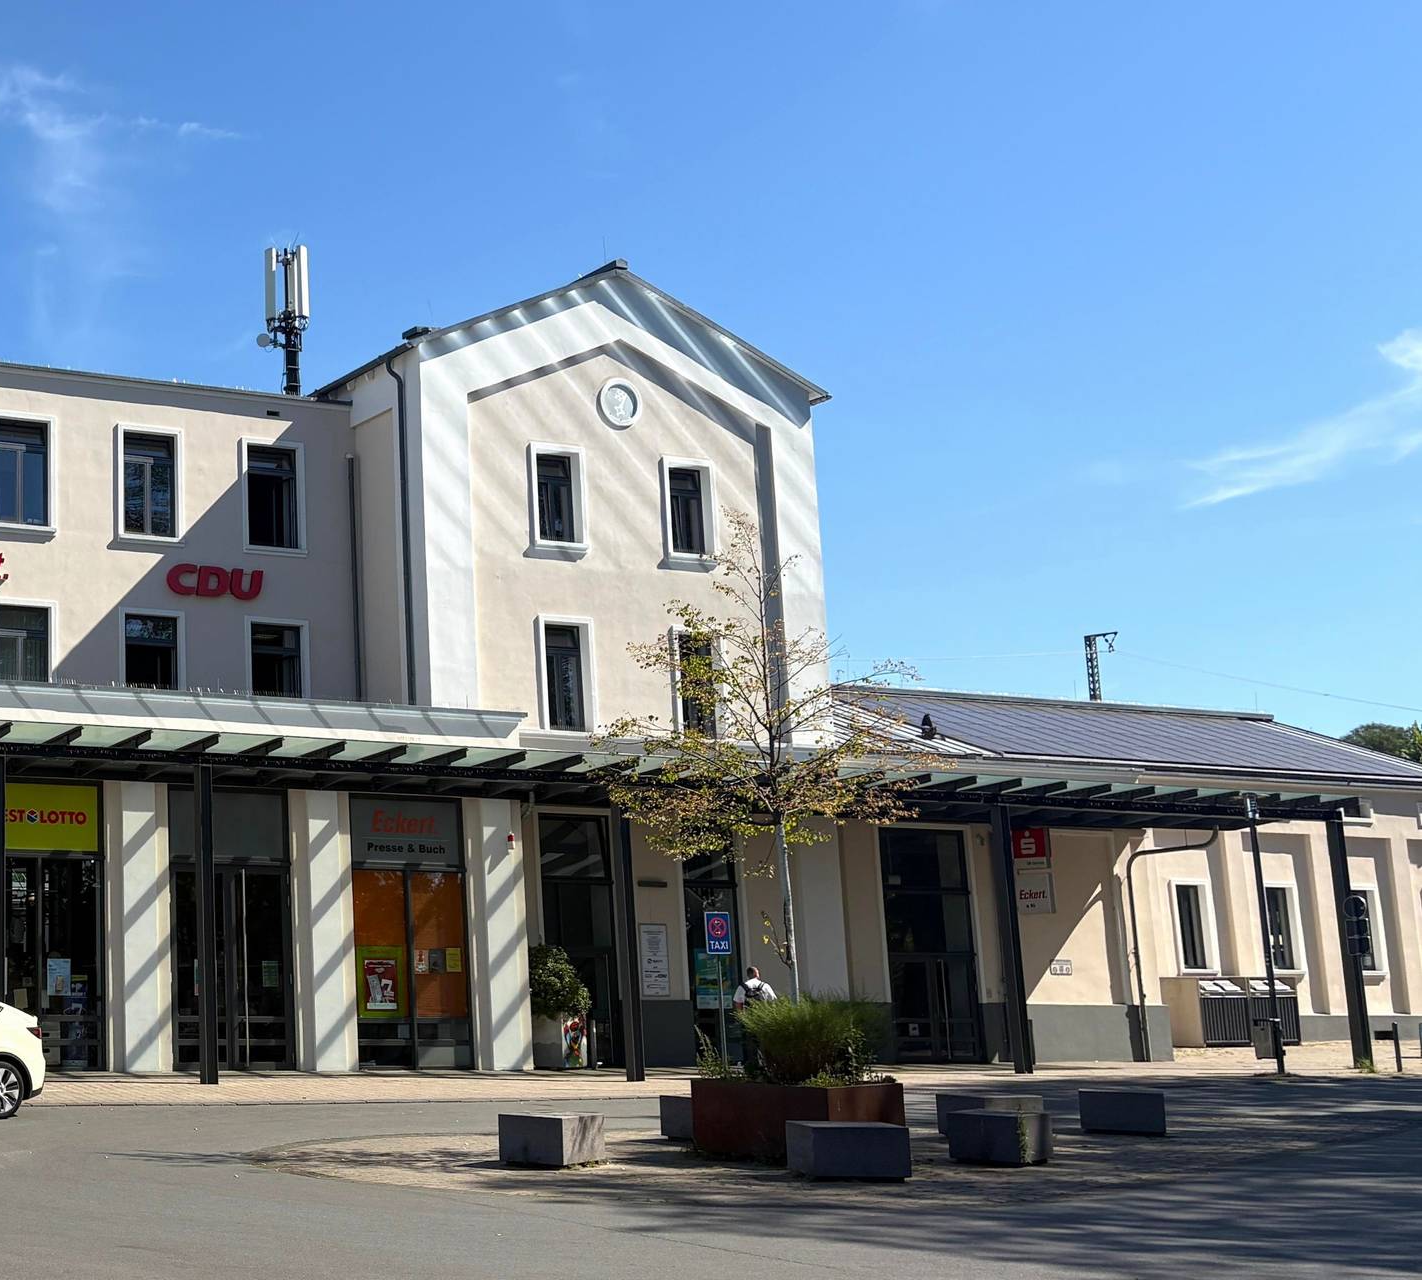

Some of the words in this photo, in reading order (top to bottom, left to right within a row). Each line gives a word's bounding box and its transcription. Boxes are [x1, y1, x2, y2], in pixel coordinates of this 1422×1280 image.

[167, 563, 264, 600] CDU
[40, 810, 87, 825] LOTTO
[367, 842, 404, 853] Presse
[407, 844, 415, 853] &
[418, 844, 446, 854] Buch
[709, 941, 729, 950] TAXI
